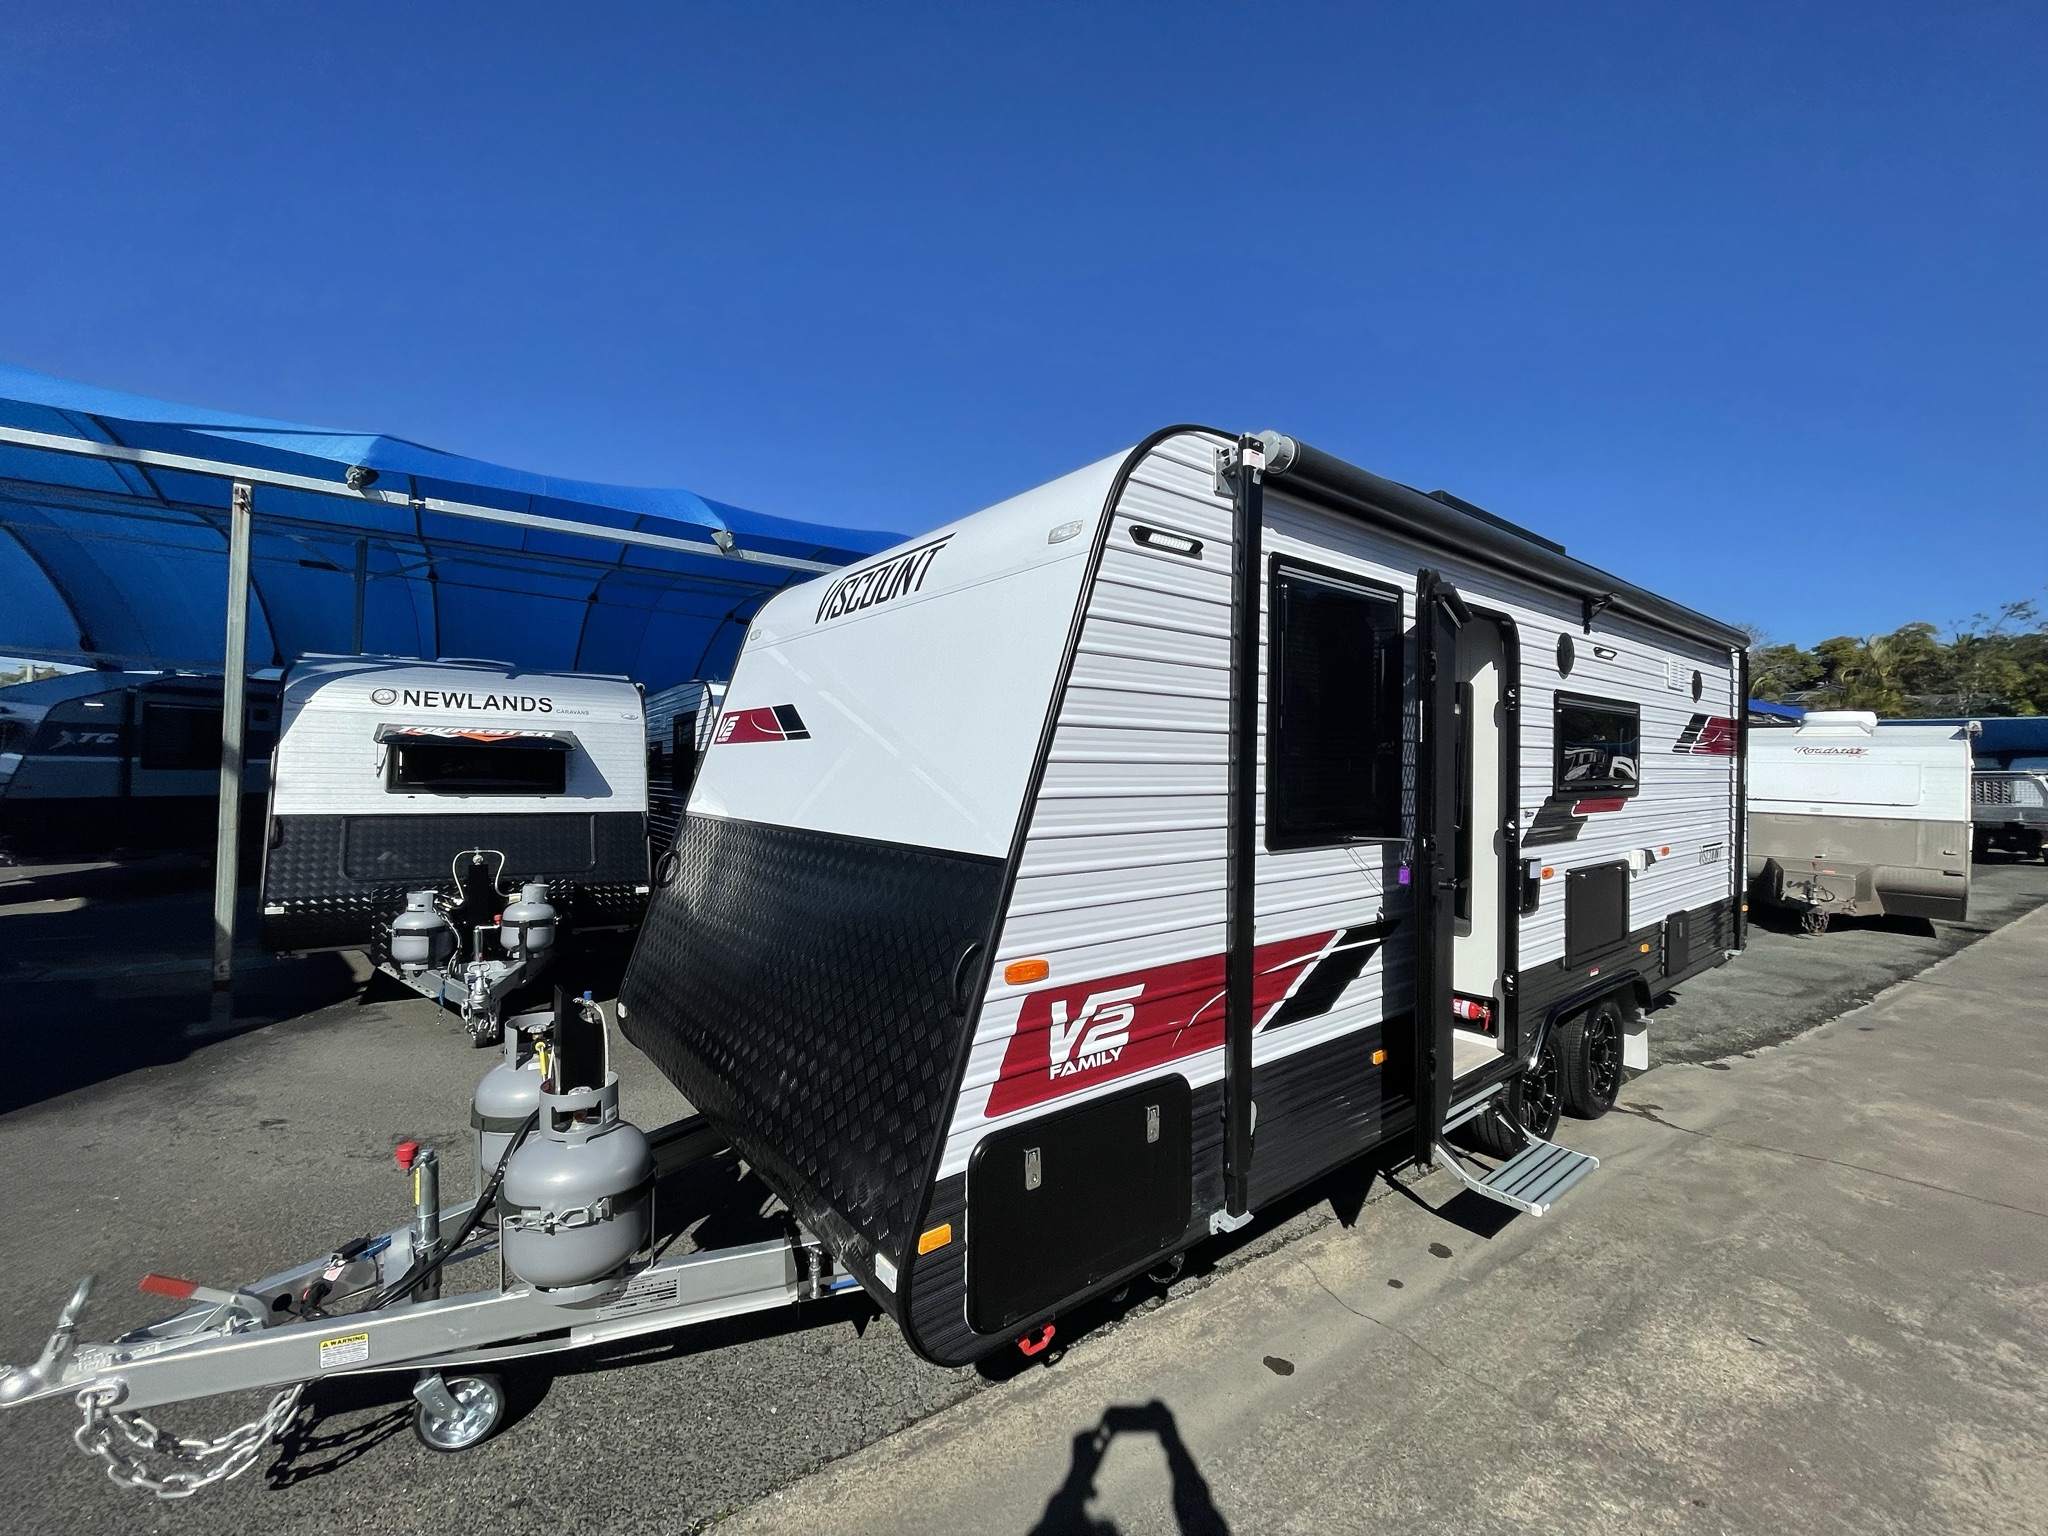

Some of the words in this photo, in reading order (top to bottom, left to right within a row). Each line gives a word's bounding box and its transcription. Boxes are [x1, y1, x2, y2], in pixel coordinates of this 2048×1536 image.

[815, 531, 957, 624] VISCOUNT
[403, 690, 553, 713] NEWLANDS
[1049, 983, 1145, 1066] V2
[1049, 1046, 1123, 1080] FAMILY
[330, 1335, 366, 1346] WARNING
